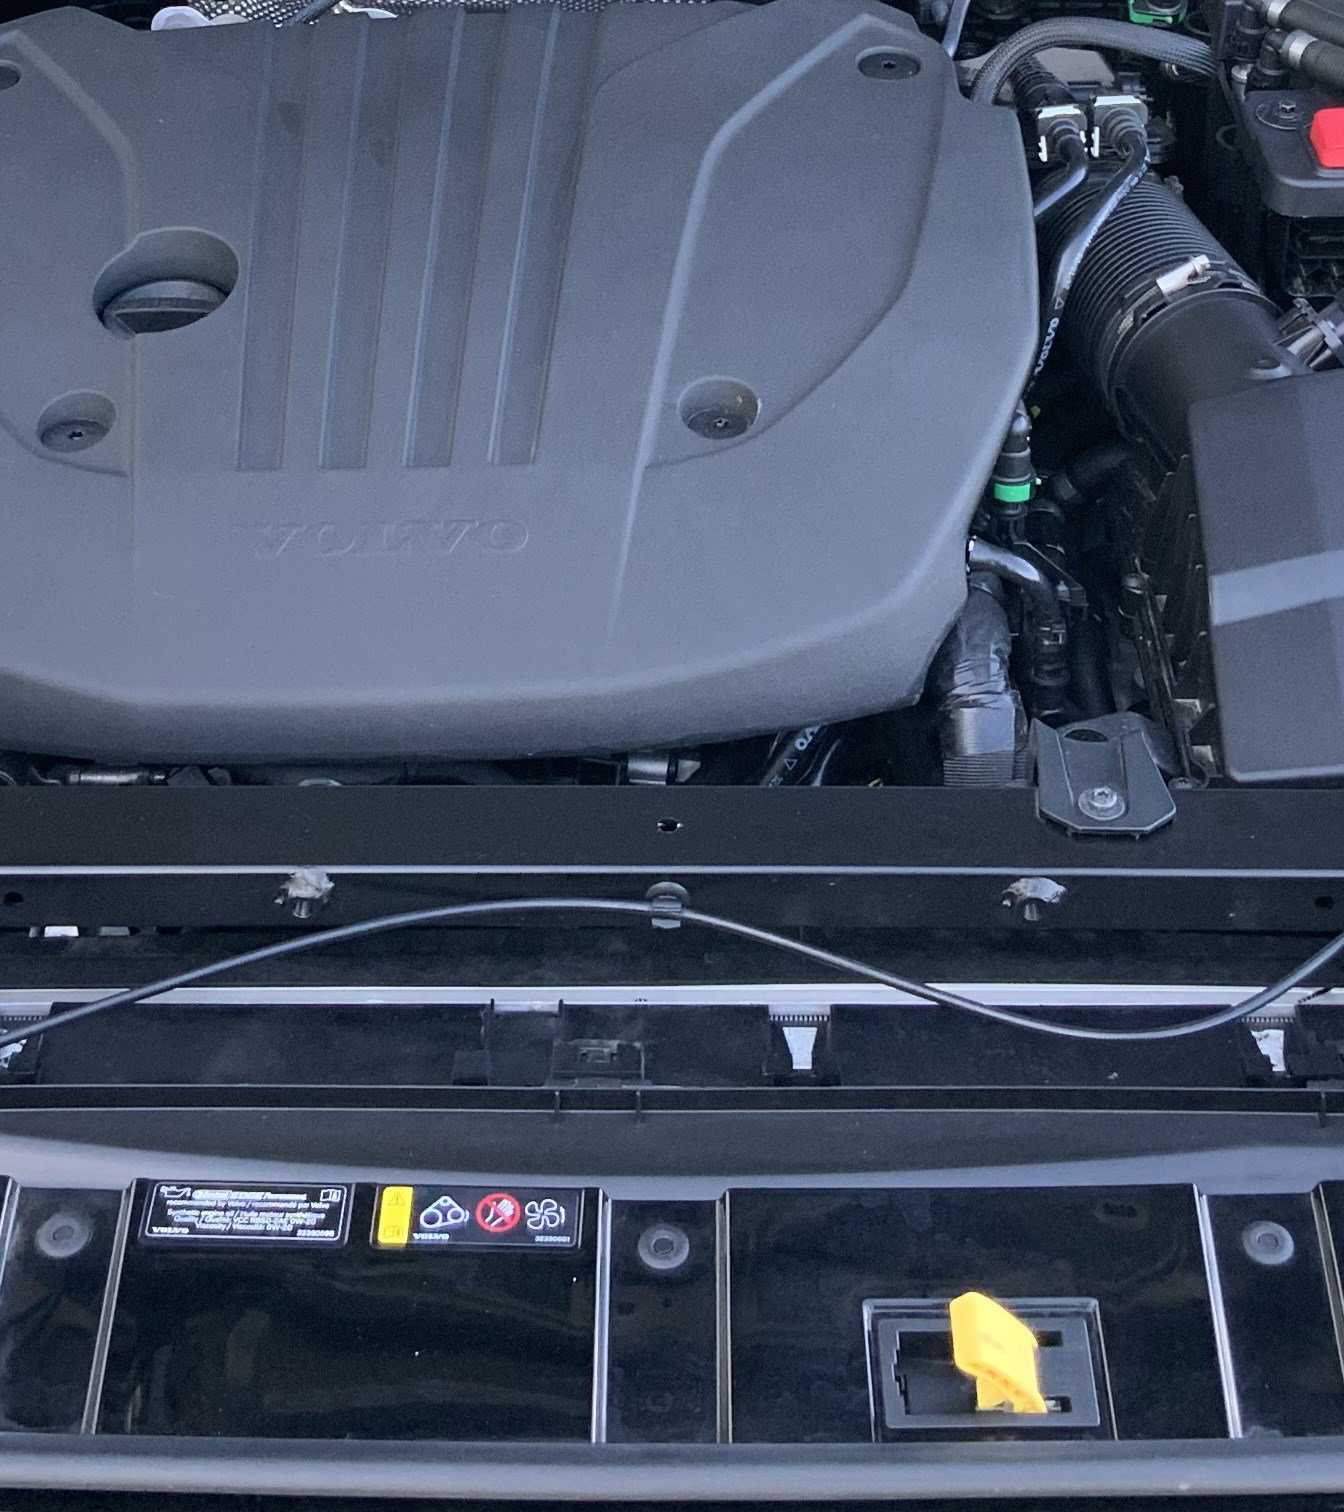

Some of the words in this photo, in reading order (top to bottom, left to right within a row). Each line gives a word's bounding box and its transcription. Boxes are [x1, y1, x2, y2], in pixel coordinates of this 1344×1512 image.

[1035, 317, 1059, 374] VOLVO
[235, 519, 530, 558] VOLVO
[152, 1226, 189, 1234] VOLVO
[412, 1232, 450, 1240] VOLVO
